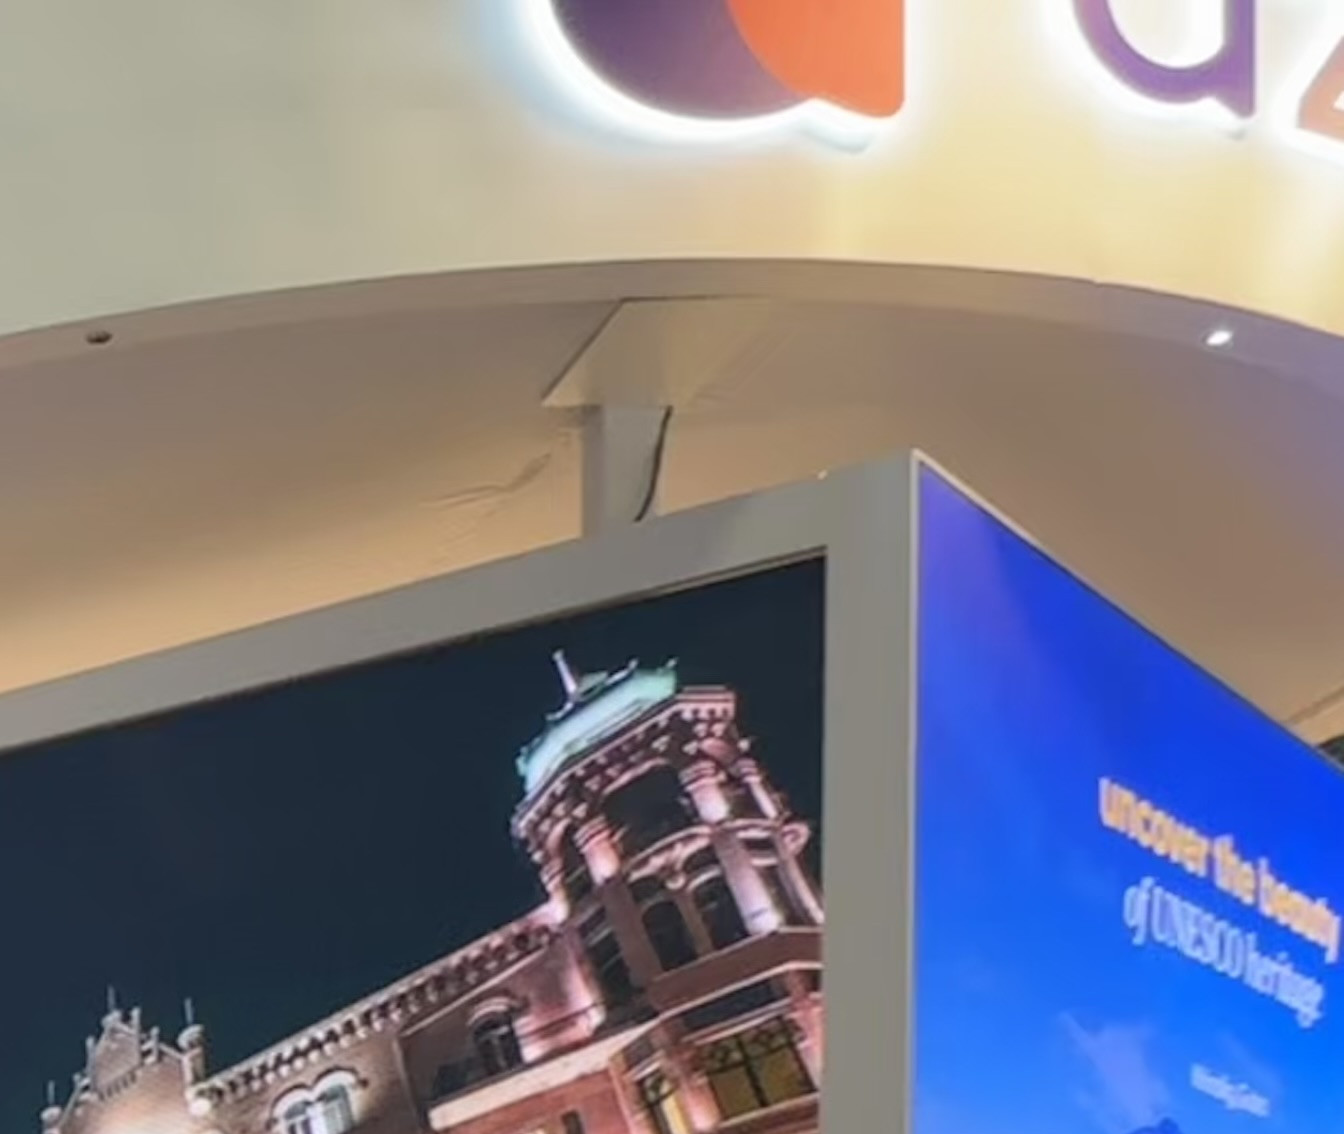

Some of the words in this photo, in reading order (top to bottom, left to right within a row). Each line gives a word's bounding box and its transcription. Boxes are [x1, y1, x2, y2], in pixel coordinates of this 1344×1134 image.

[1098, 776, 1210, 878] uncover
[1212, 833, 1257, 905] the
[1122, 876, 1155, 946] of
[1151, 885, 1244, 979] UNESCO
